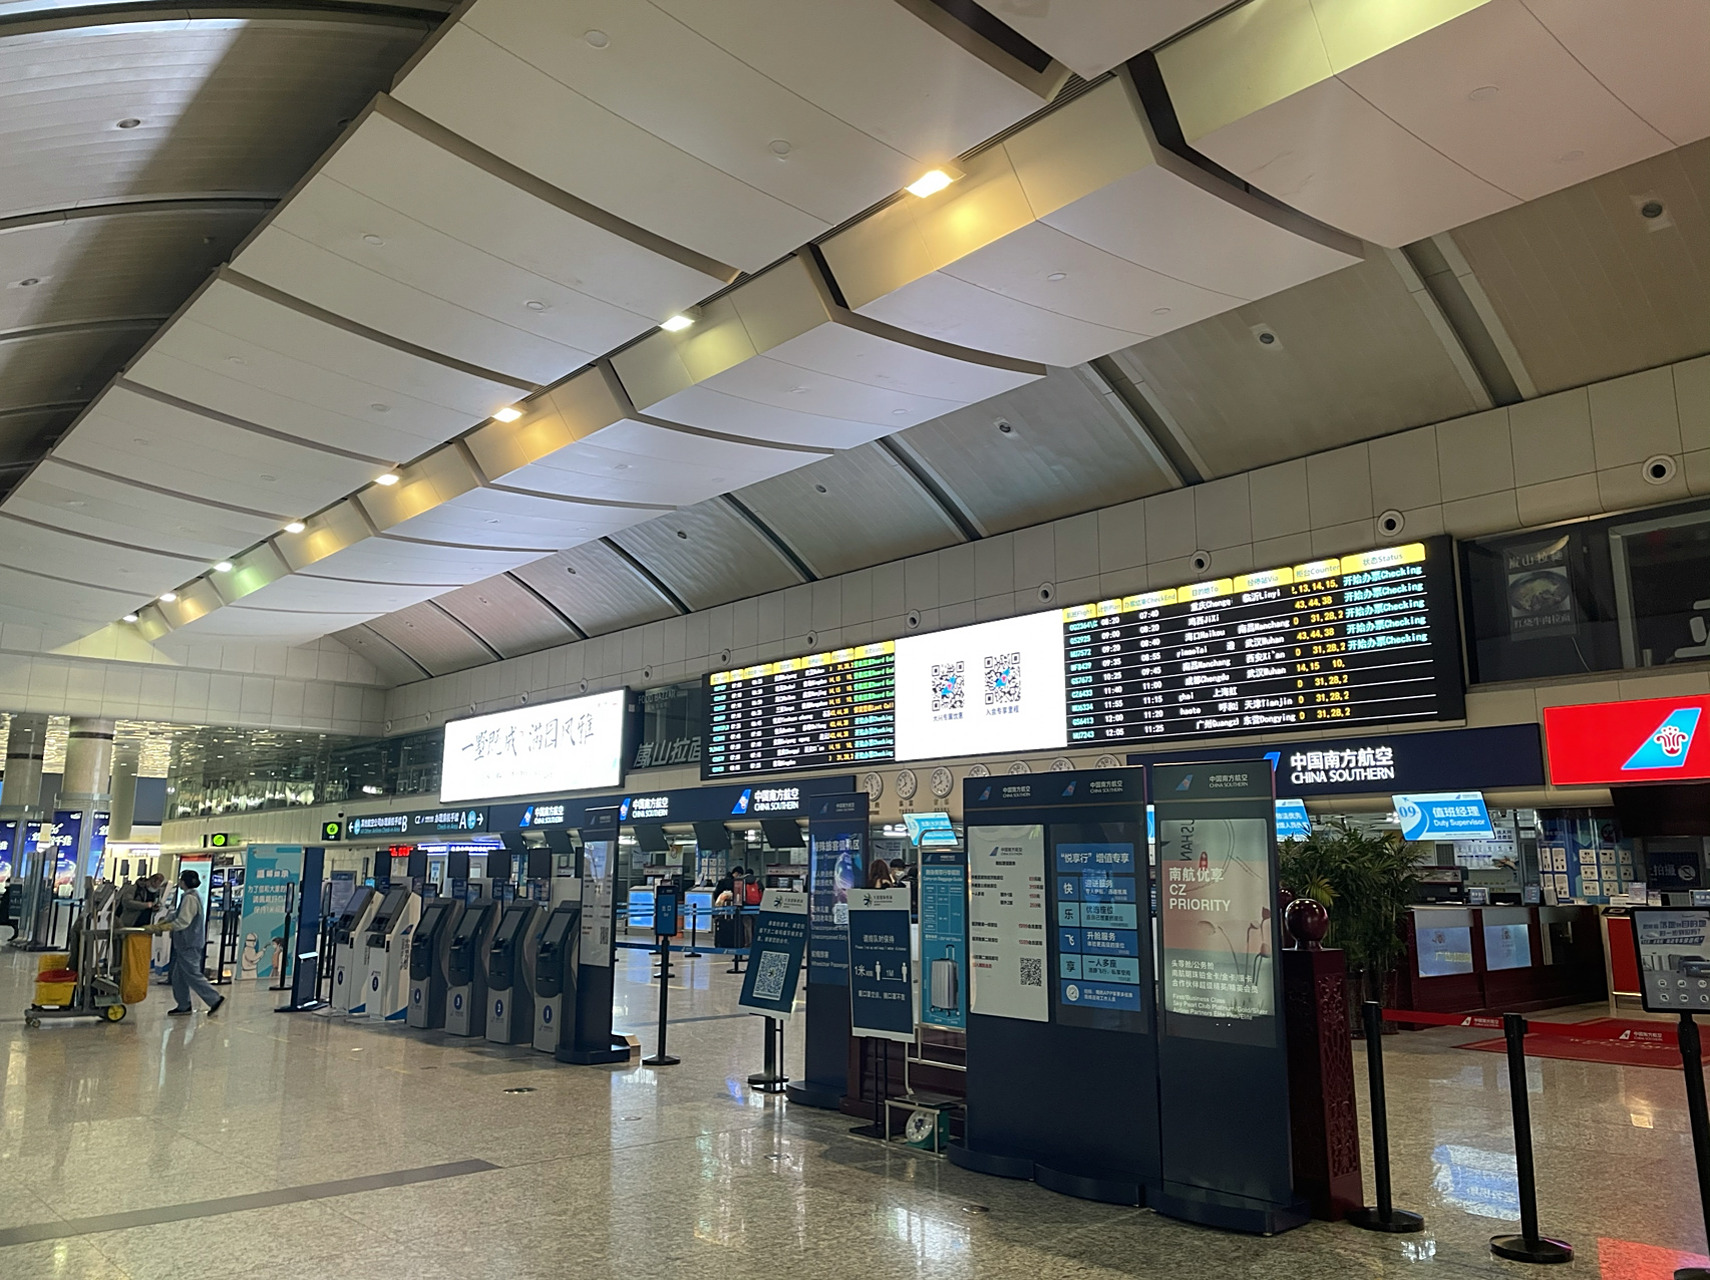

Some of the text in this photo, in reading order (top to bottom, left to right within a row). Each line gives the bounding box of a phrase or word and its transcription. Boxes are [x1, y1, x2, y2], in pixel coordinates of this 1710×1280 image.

[1362, 553, 1403, 567] 状态Status
[1343, 566, 1423, 587] 开始办票Checking
[1344, 583, 1424, 602] 开始办票Checking
[1345, 599, 1426, 619] 开始办票Checking
[1346, 616, 1427, 635] 开始办票Checking
[1347, 633, 1428, 651] 开始办票Checking
[1290, 746, 1394, 771] 中国南方航空
[1209, 774, 1248, 782] 中国南方航空
[1291, 767, 1394, 784] CHINA SOUTHERN
[1090, 780, 1123, 788] 中国南方航空
[754, 788, 800, 802] 中国南方航空
[632, 797, 669, 810] 中国南方航空
[1398, 806, 1416, 818] 09
[1433, 806, 1480, 818] 值班经理
[402, 815, 408, 833] B
[459, 811, 467, 830] A
[1434, 819, 1485, 828] Duty Supervisor
[1096, 853, 1129, 864] 增值专享
[1169, 867, 1224, 882] 南航优享
[1063, 883, 1073, 895] 快
[1169, 884, 1187, 896] CZ
[1169, 898, 1230, 911] PRIORITY
[1065, 909, 1074, 920] 乐
[1065, 934, 1075, 946] 飞
[1066, 961, 1076, 972] 享
[1088, 959, 1117, 968] 一人多座
[1171, 960, 1214, 970] 头等舱/公务舱
